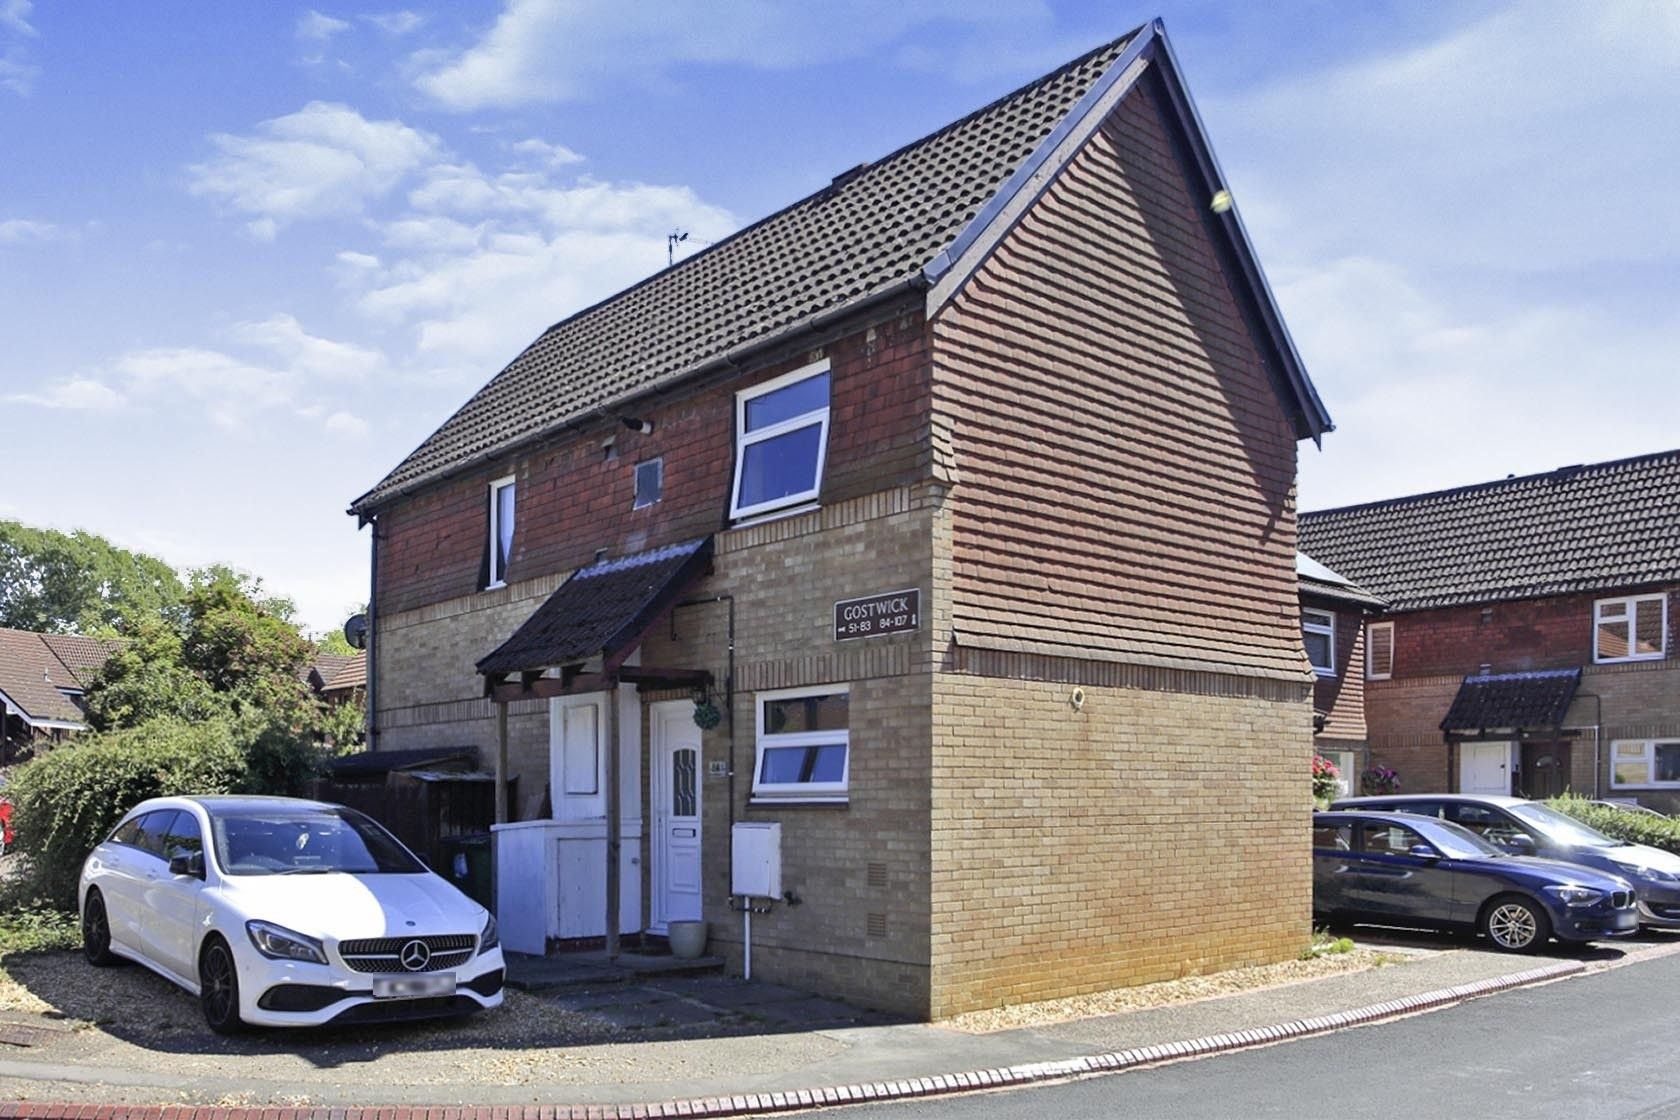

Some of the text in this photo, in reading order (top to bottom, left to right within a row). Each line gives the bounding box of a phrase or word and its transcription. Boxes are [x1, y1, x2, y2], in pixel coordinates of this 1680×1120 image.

[844, 597, 908, 620] GOSTWICK
[848, 615, 907, 633] 51-83 84-107
